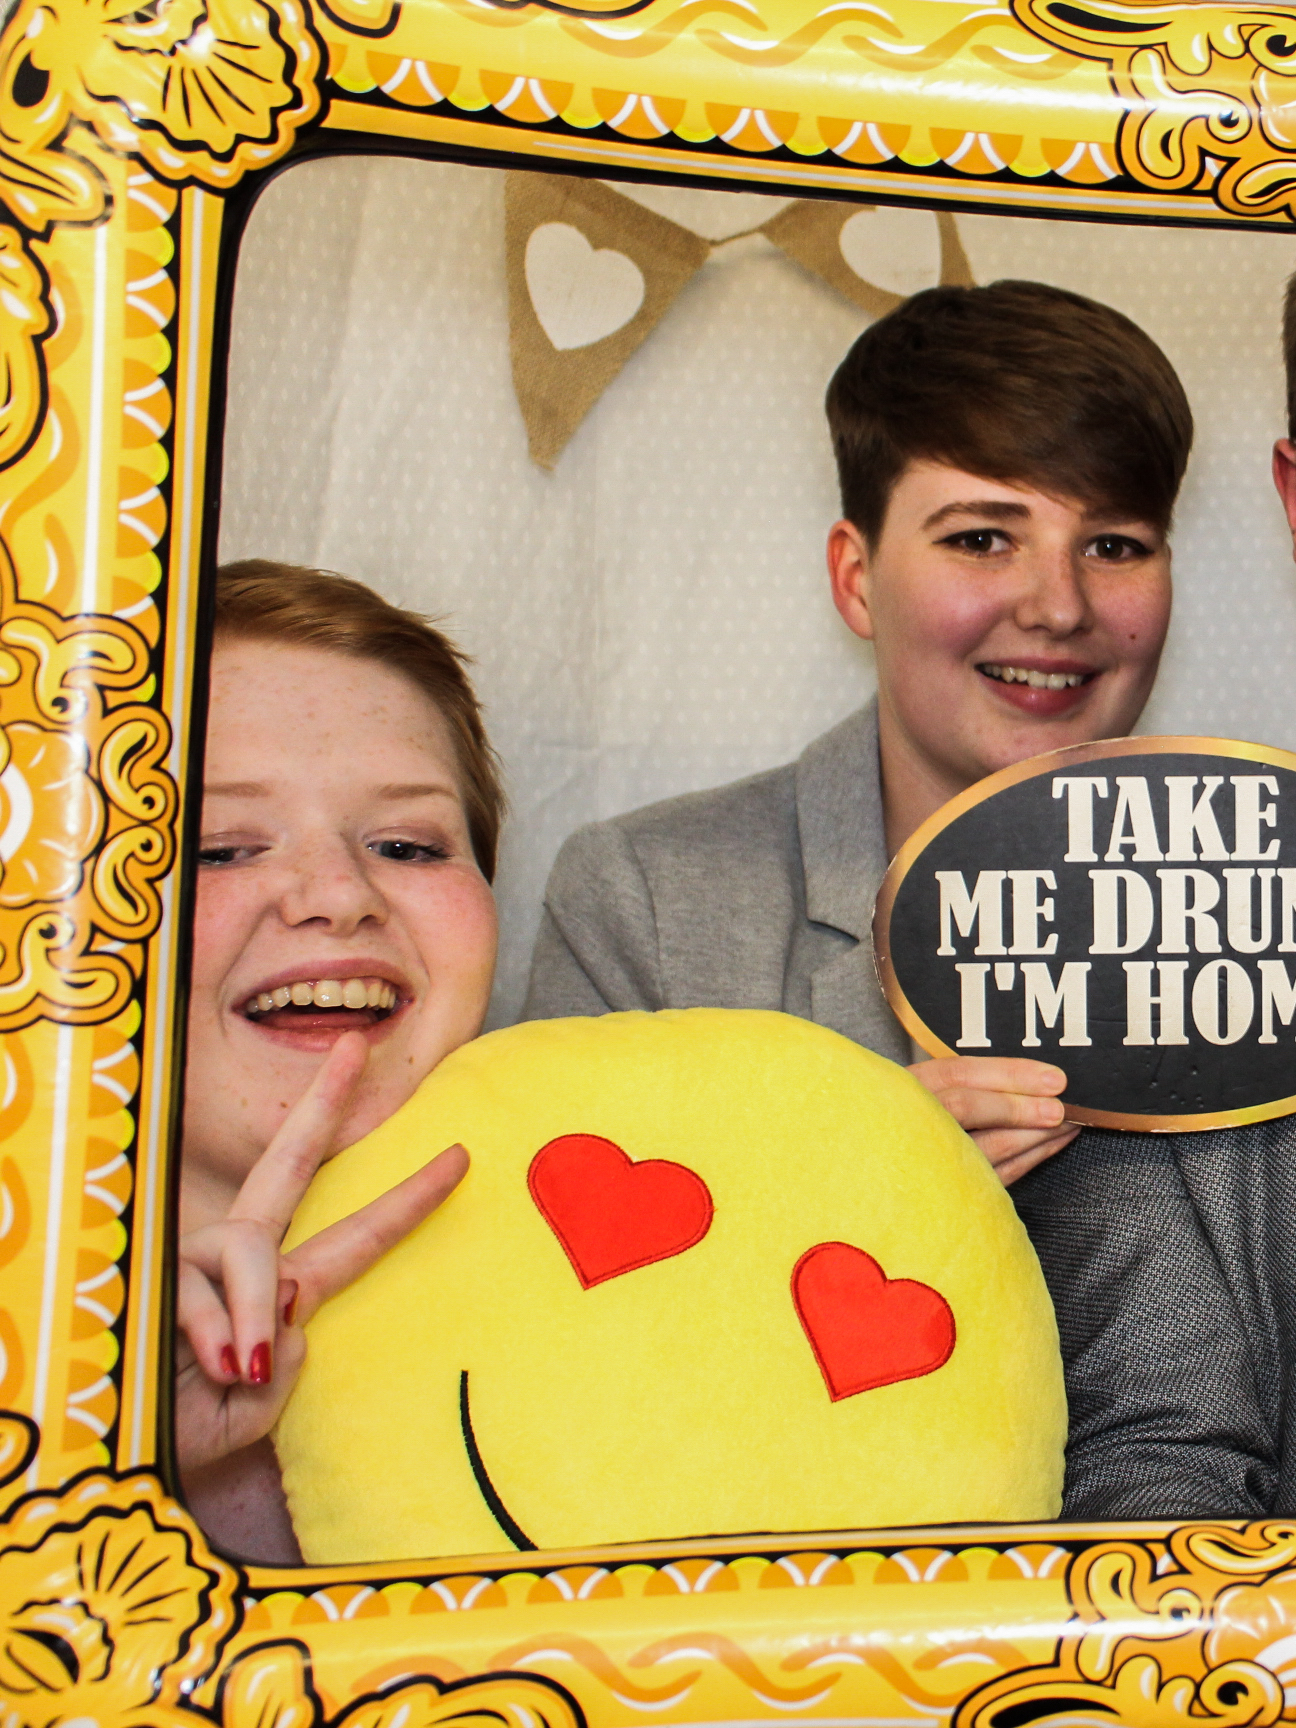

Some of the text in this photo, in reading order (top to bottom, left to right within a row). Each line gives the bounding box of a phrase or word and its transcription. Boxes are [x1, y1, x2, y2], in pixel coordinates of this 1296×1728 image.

[1052, 776, 1281, 862] TAKE
[935, 870, 1058, 956] ME
[955, 962, 1092, 1047] I'M
